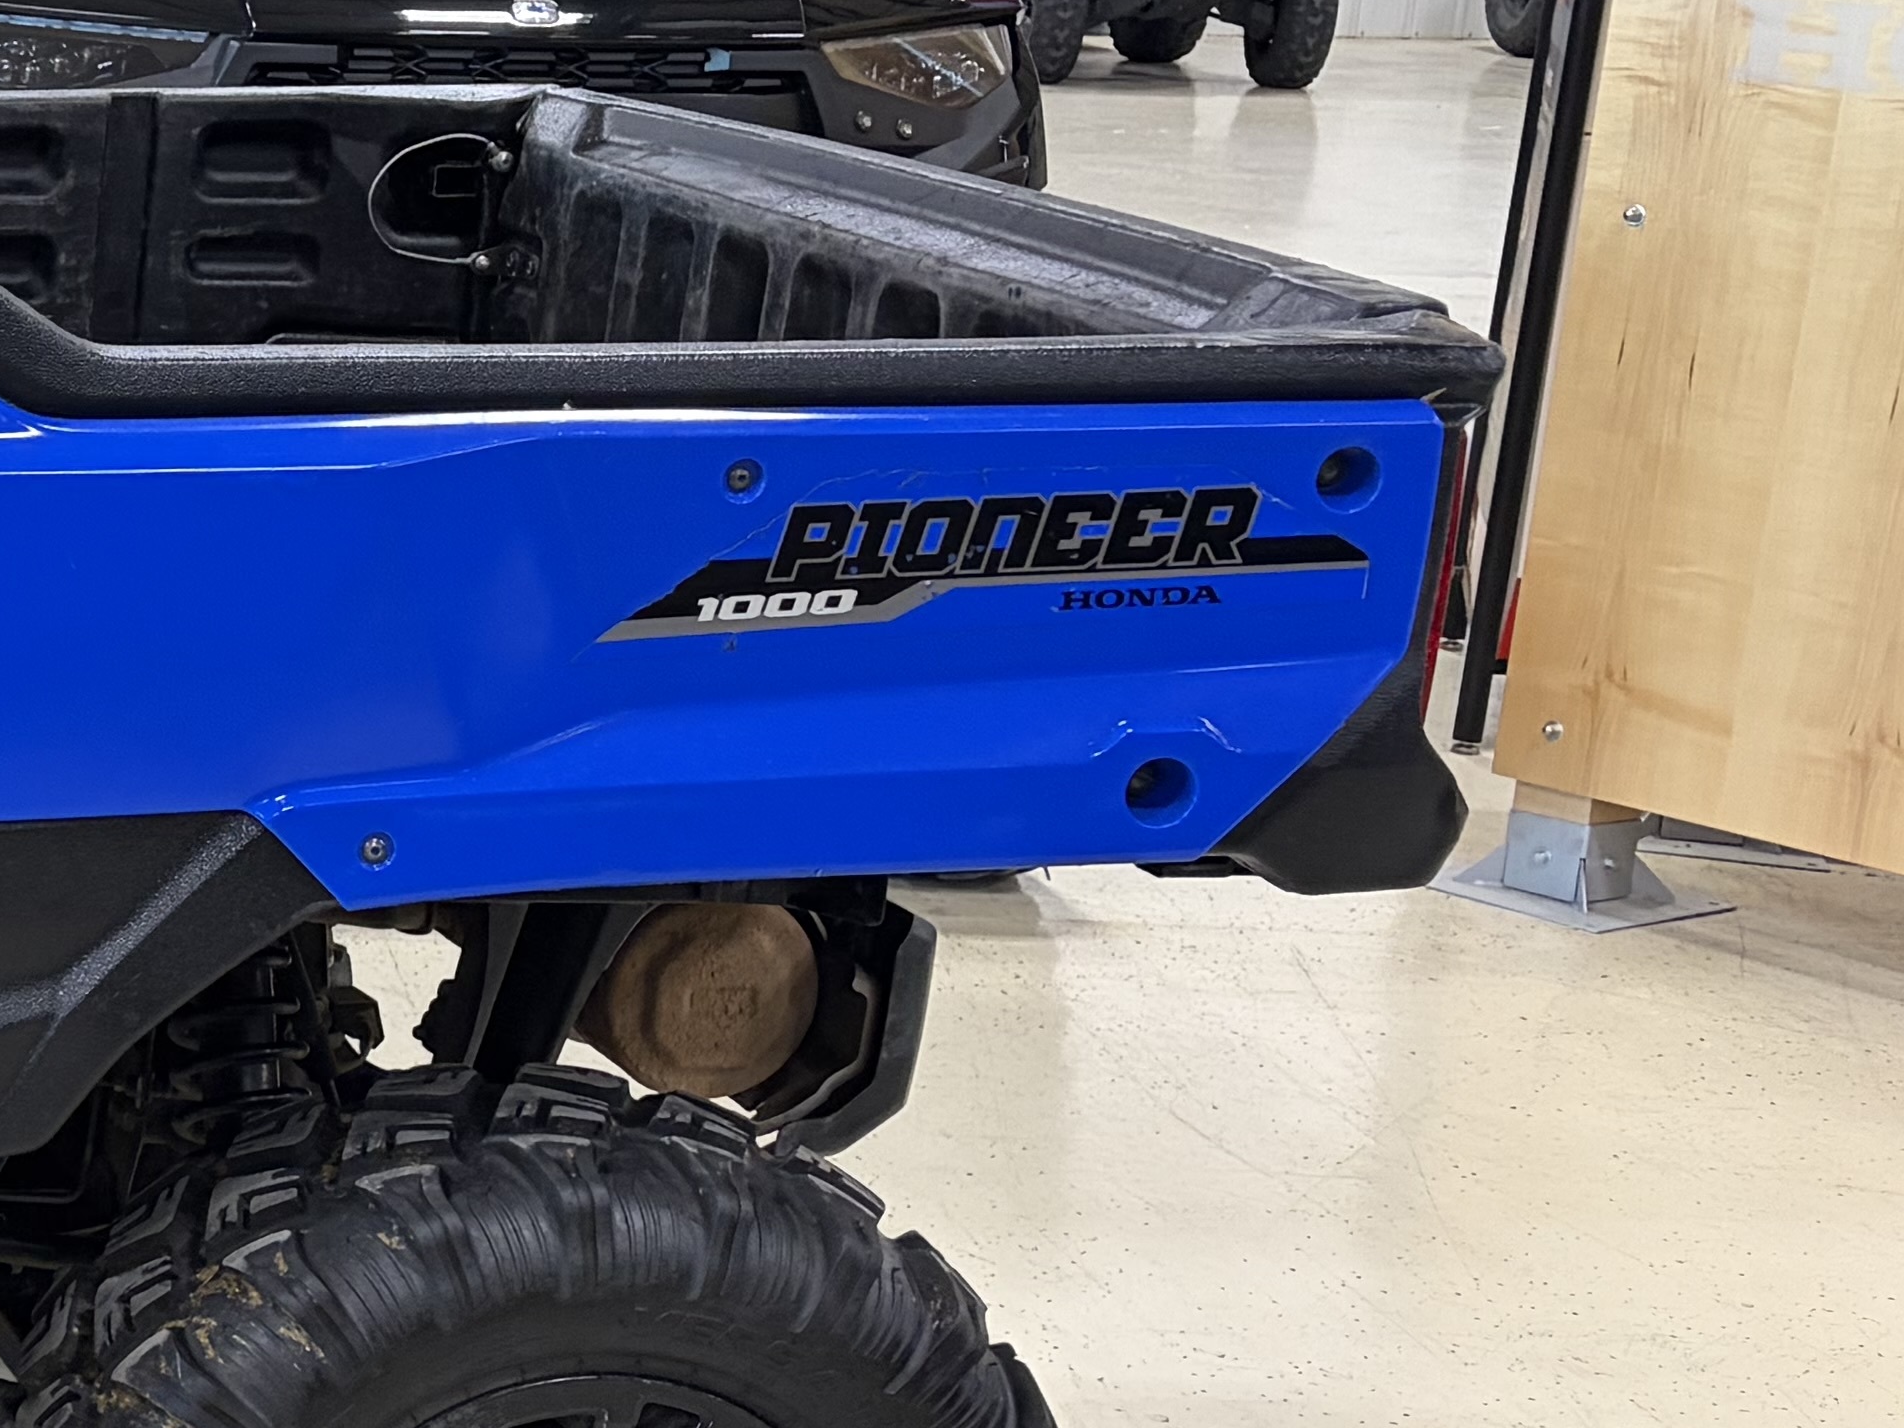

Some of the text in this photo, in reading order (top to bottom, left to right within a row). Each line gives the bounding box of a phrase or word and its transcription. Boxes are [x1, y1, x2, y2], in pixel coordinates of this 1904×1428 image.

[765, 486, 1263, 583] PIONEER
[696, 585, 1222, 622] 1000 HONDA
